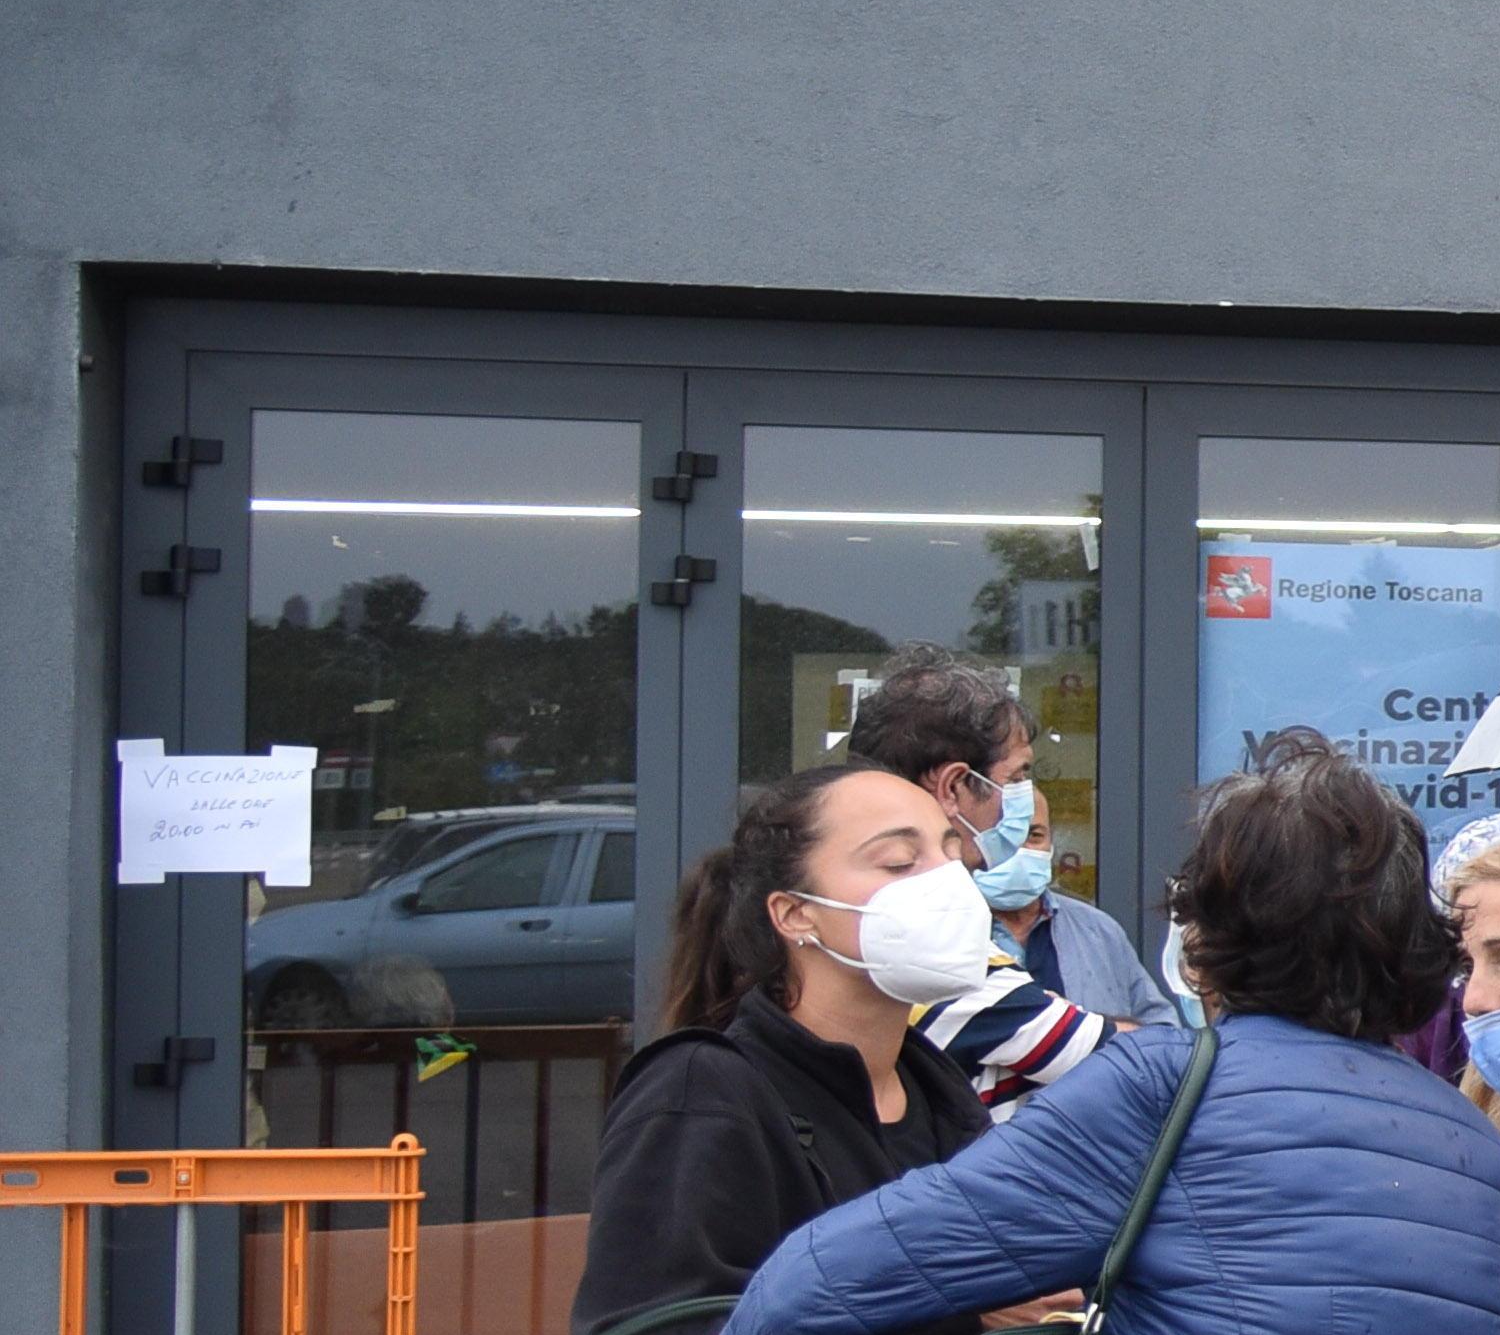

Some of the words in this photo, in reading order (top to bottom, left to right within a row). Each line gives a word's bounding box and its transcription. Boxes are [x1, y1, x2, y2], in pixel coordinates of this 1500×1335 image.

[1278, 578, 1376, 603] Regione
[1384, 581, 1483, 603] Toscana
[1383, 688, 1489, 722] Cent
[144, 764, 305, 789] VACCINAZIONE
